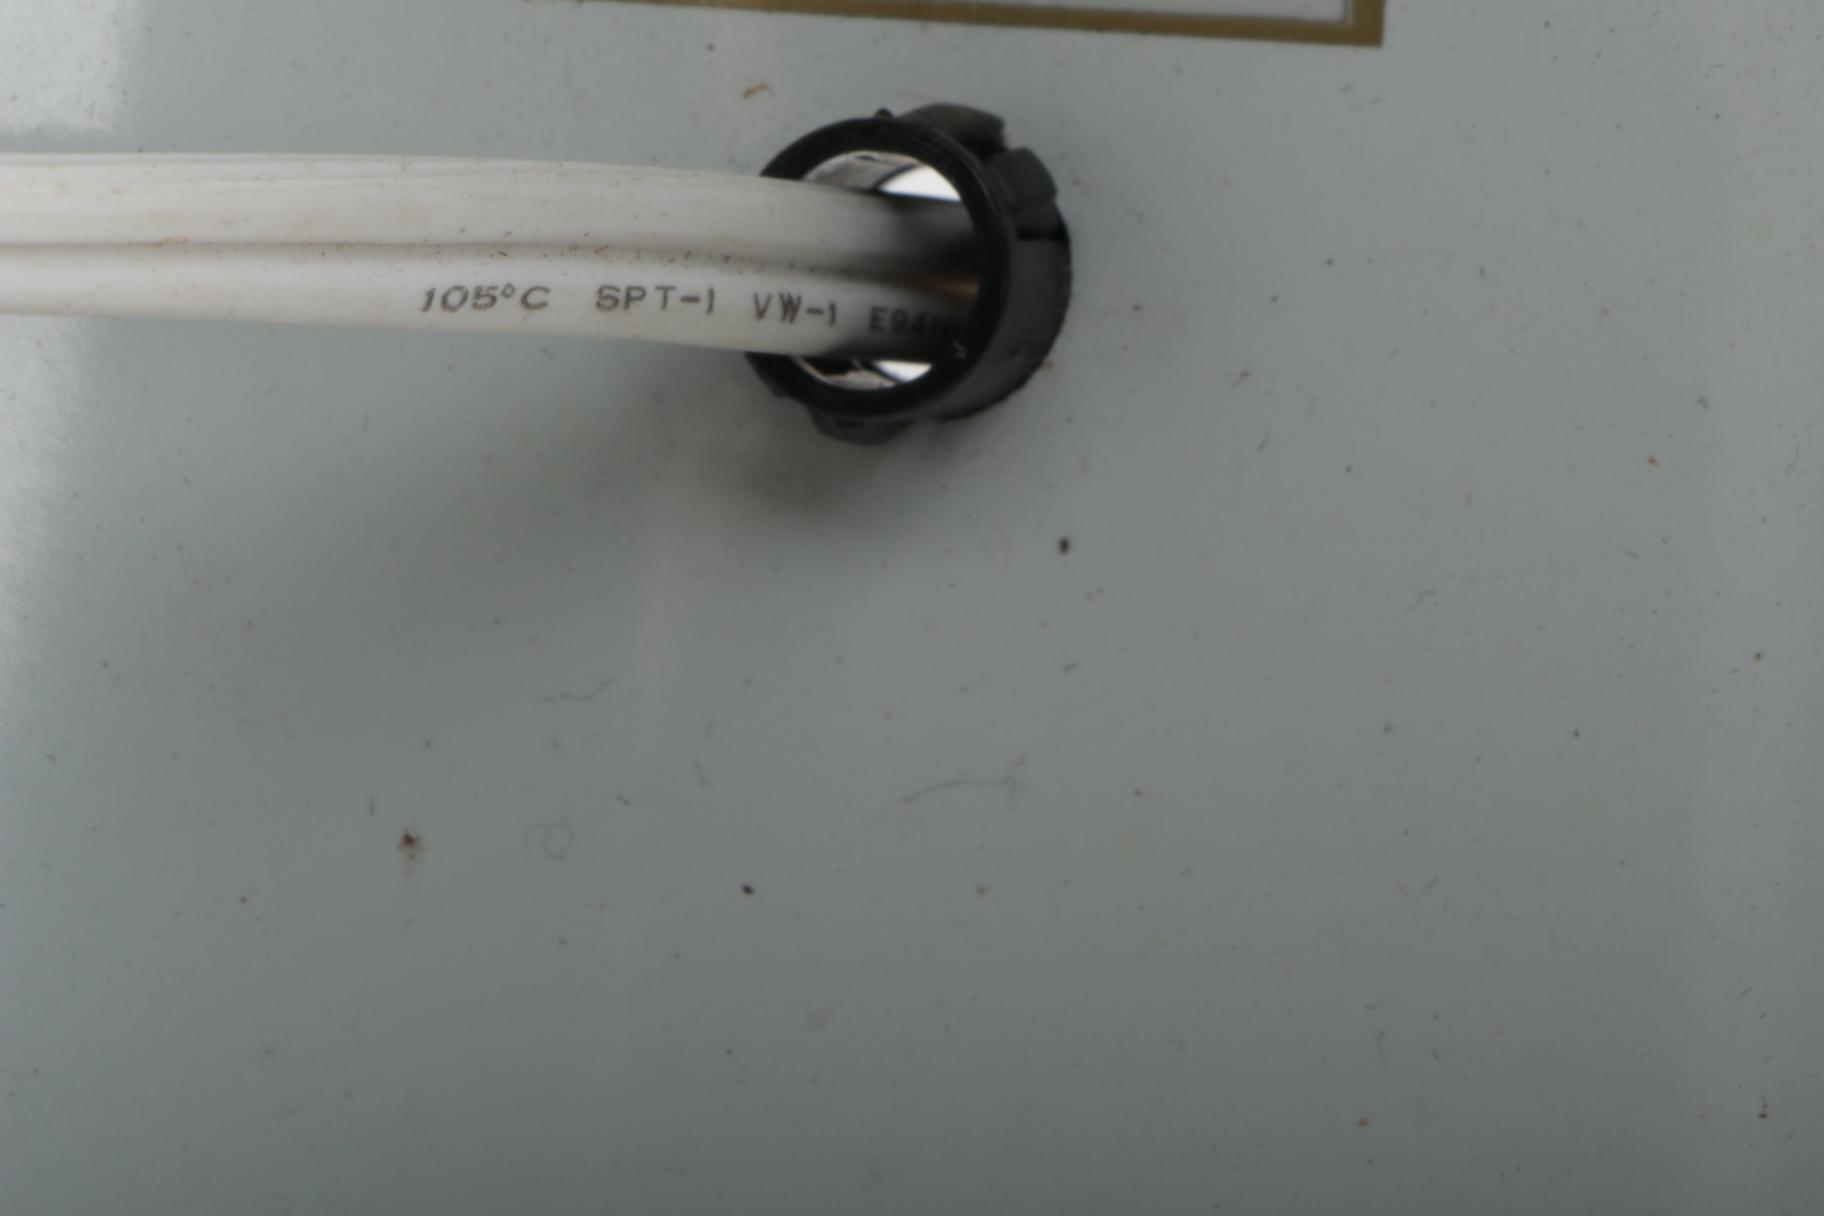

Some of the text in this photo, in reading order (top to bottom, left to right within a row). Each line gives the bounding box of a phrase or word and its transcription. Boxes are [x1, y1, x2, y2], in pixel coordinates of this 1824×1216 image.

[421, 284, 550, 313] 105°C
[596, 284, 715, 316] SPT-1
[753, 294, 838, 327] VW-1
